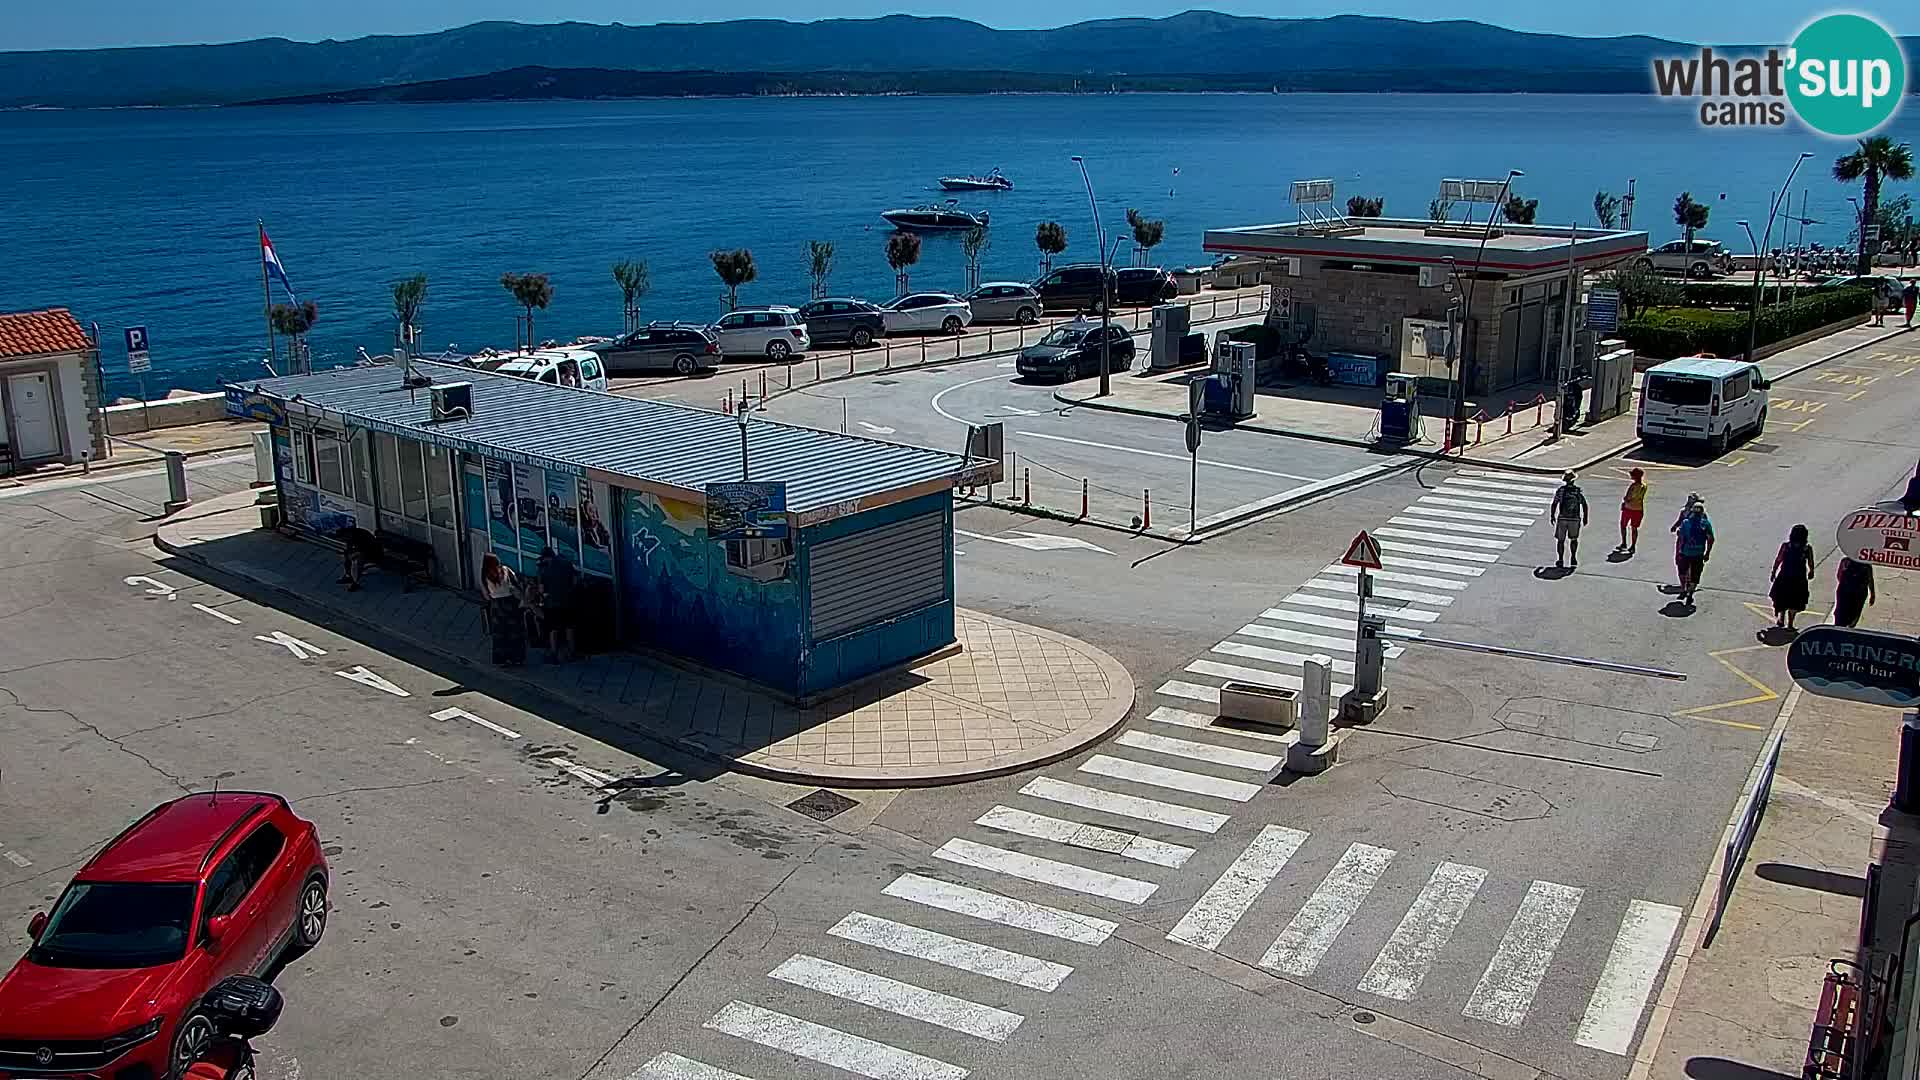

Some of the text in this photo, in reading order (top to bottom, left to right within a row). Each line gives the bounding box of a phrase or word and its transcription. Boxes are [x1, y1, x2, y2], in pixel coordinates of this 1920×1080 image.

[129, 330, 142, 349] P
[435, 435, 468, 450] POSTAJA
[478, 444, 493, 456] BUS
[493, 448, 526, 464] STATION
[528, 456, 555, 470] TICKET
[555, 462, 583, 477] OFFICE
[1848, 513, 1920, 532] PIZZE
[1880, 529, 1917, 539] GRILL
[1870, 663, 1896, 678] bar
